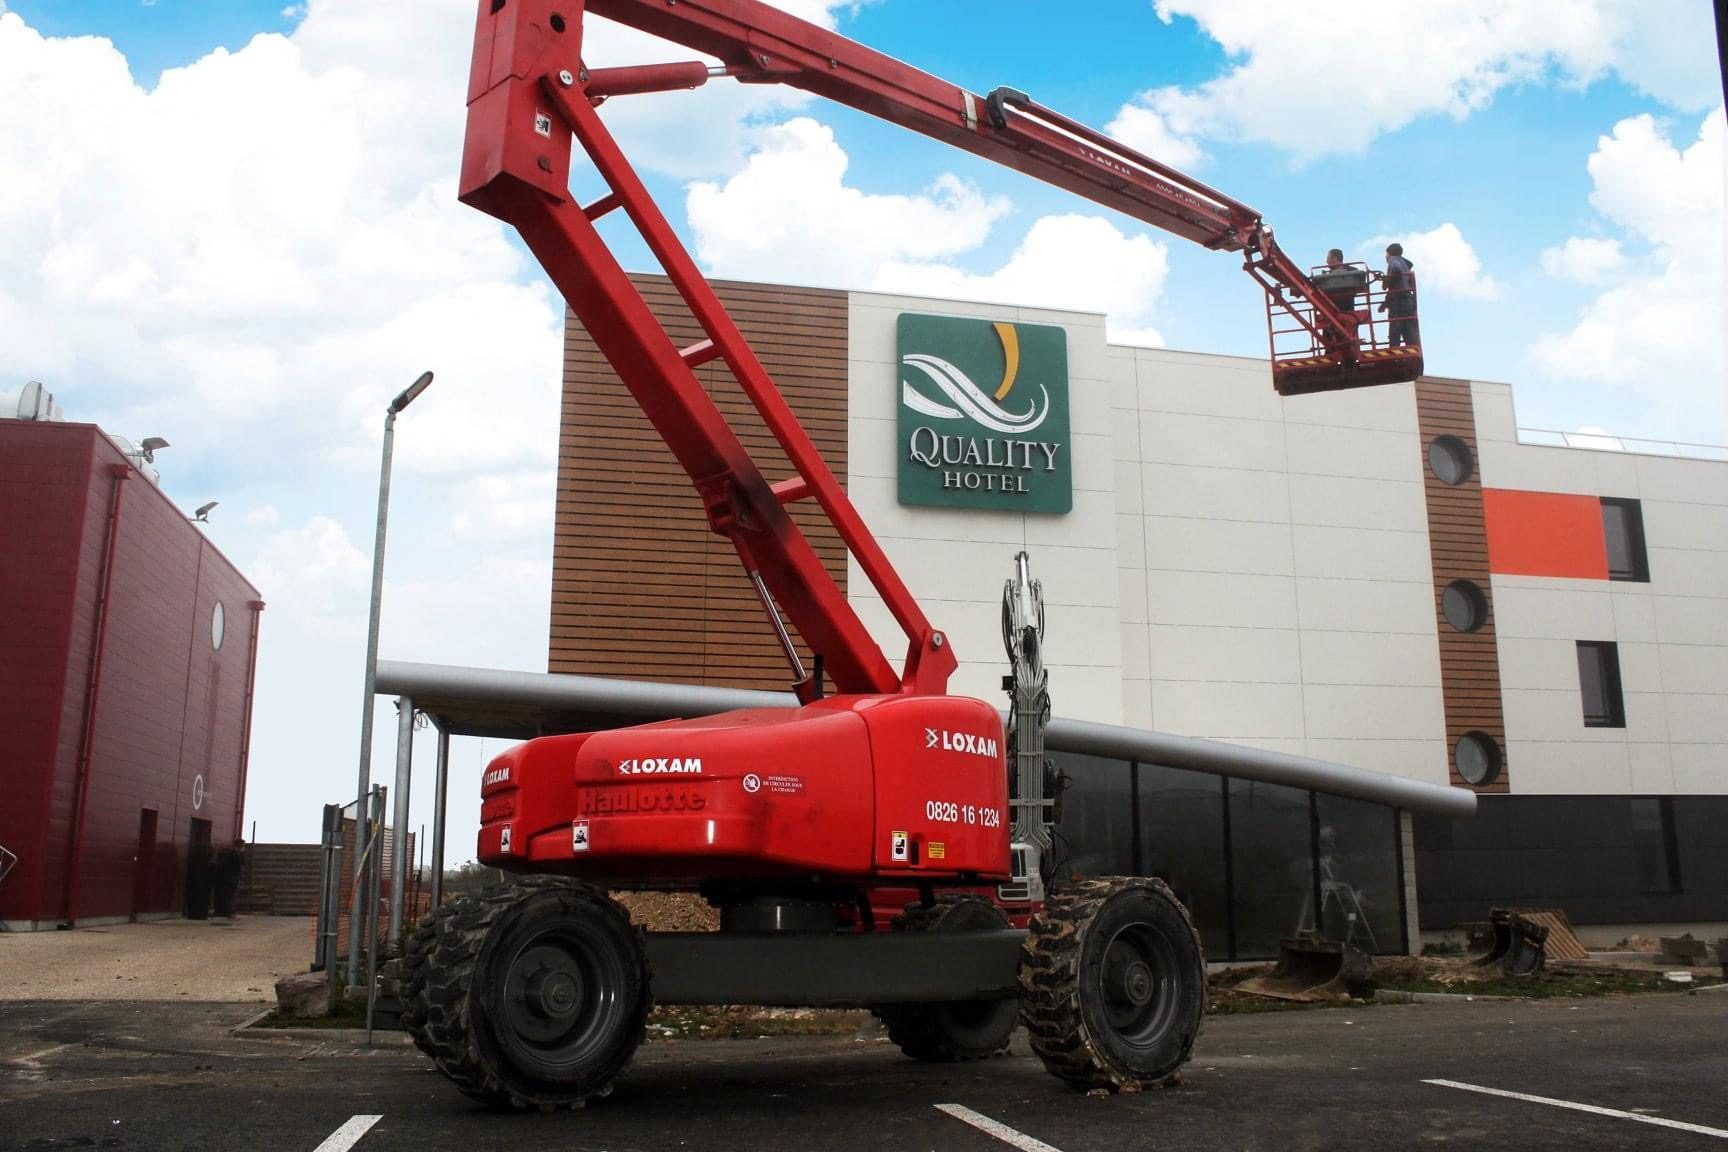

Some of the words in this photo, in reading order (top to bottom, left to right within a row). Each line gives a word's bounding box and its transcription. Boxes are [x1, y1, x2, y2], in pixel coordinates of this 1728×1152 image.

[910, 426, 1061, 471] QUALITY
[943, 471, 1029, 492] HOTEL
[942, 730, 998, 759] LOXAM
[631, 758, 702, 774] LOXAM
[581, 786, 707, 815] Haulotte
[926, 800, 958, 822] 0826
[962, 804, 975, 825] 16
[978, 807, 1000, 828] 1234
